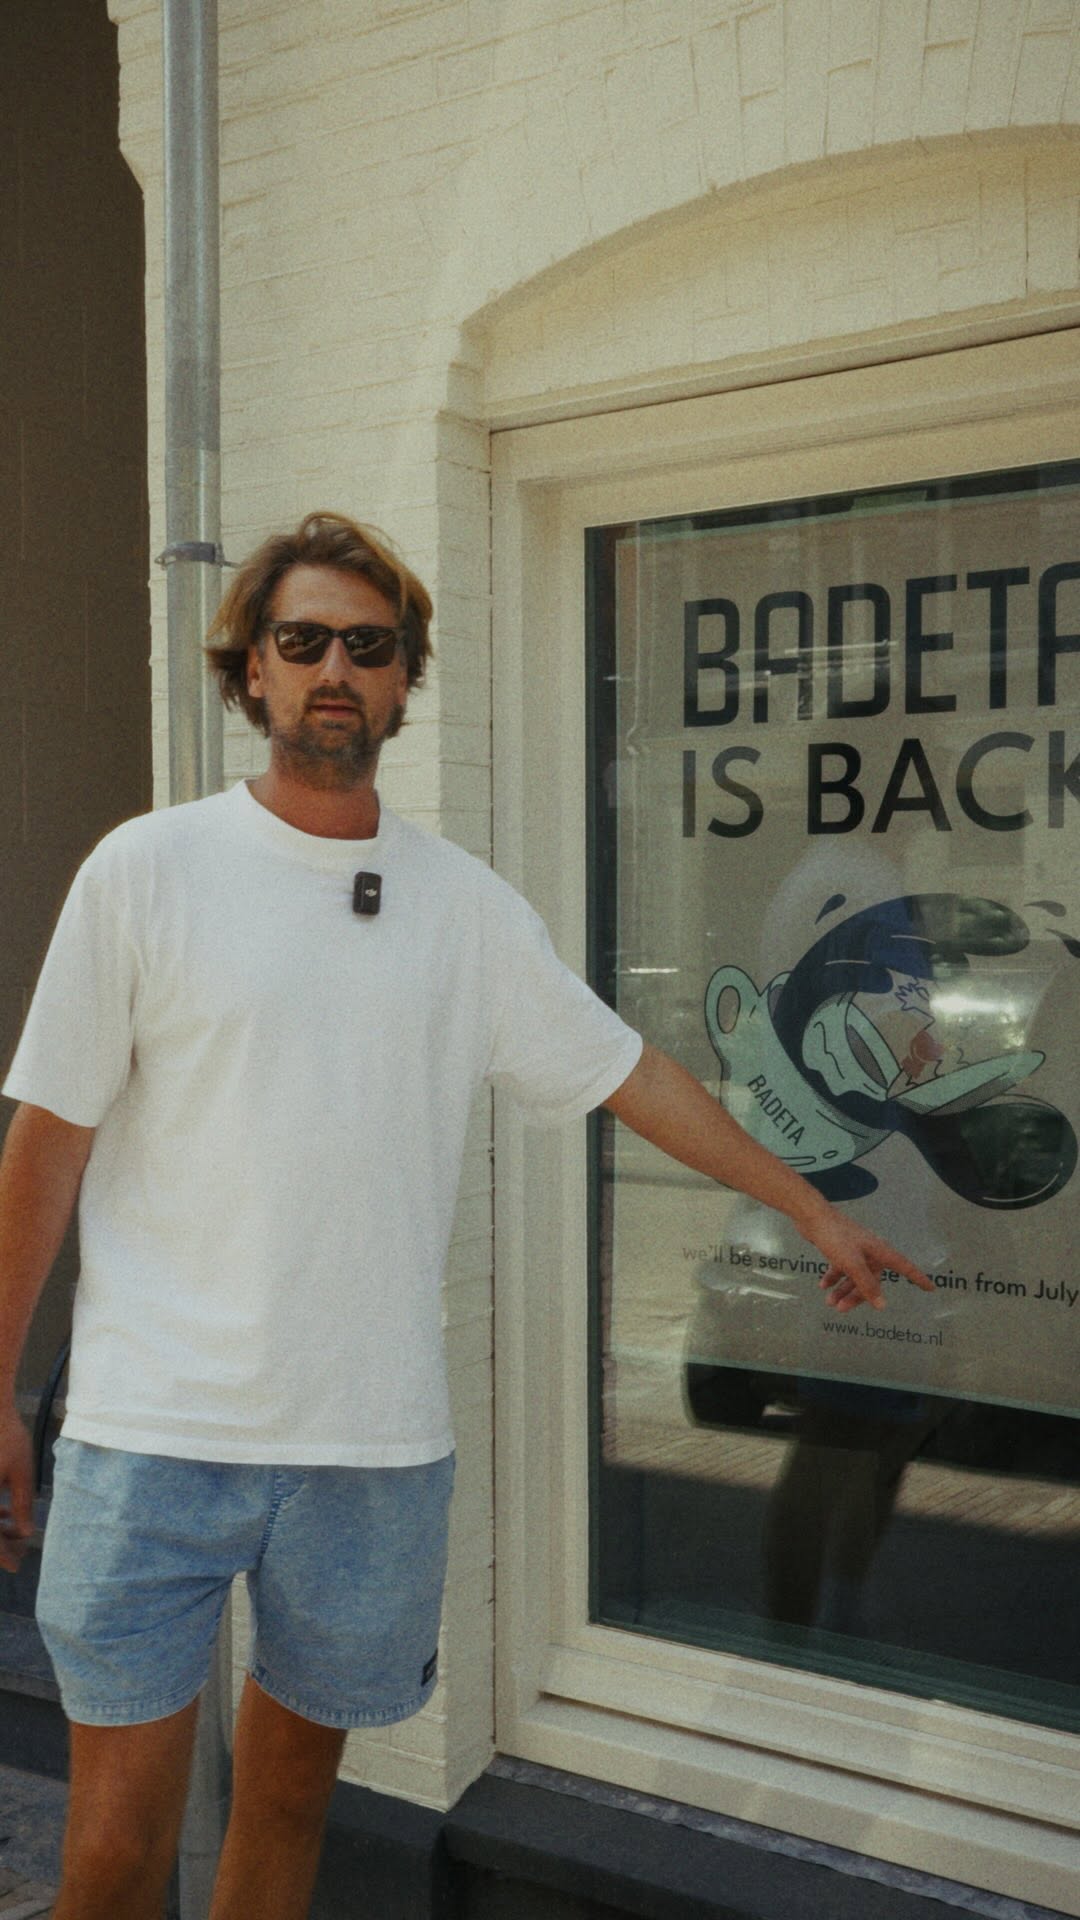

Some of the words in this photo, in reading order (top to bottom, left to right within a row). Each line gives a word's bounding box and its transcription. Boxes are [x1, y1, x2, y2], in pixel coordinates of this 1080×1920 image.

[684, 561, 1080, 728] BADETA
[682, 745, 764, 838] IS
[747, 1074, 806, 1147] BADETA
[682, 1244, 723, 1264] we'll
[730, 1246, 752, 1267] be
[759, 1254, 830, 1280] serving
[975, 1272, 1027, 1297] from
[1034, 1279, 1079, 1308] July
[822, 1320, 944, 1347] www.badeta.nl
